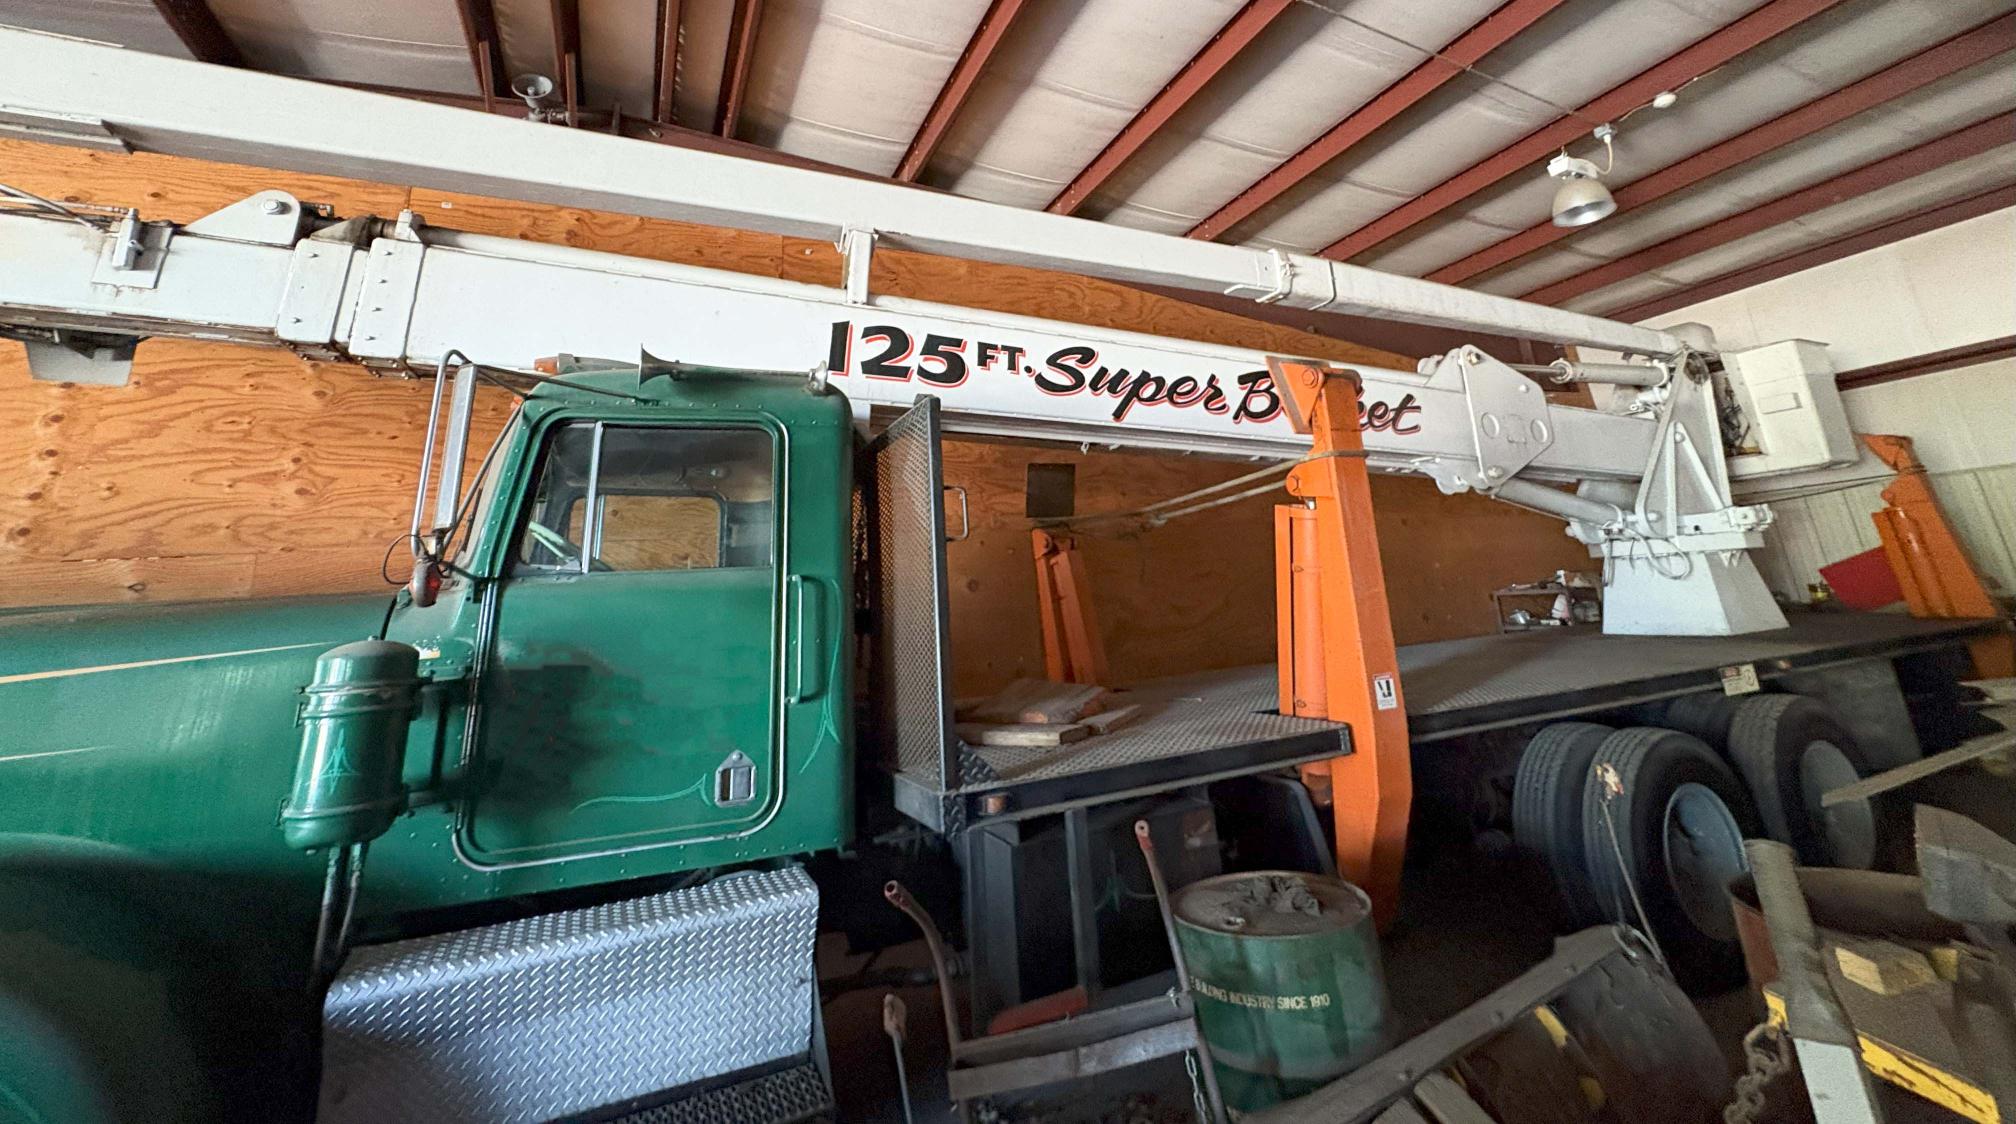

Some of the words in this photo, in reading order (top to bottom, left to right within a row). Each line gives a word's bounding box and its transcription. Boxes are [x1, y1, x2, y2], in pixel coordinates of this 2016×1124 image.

[828, 320, 970, 388] 125
[976, 341, 1035, 377] FT.
[1034, 346, 1230, 423] Super
[1229, 991, 1275, 1009] INDUSTRY
[1277, 995, 1308, 1009] SINCE
[1310, 993, 1330, 1008] 1910
